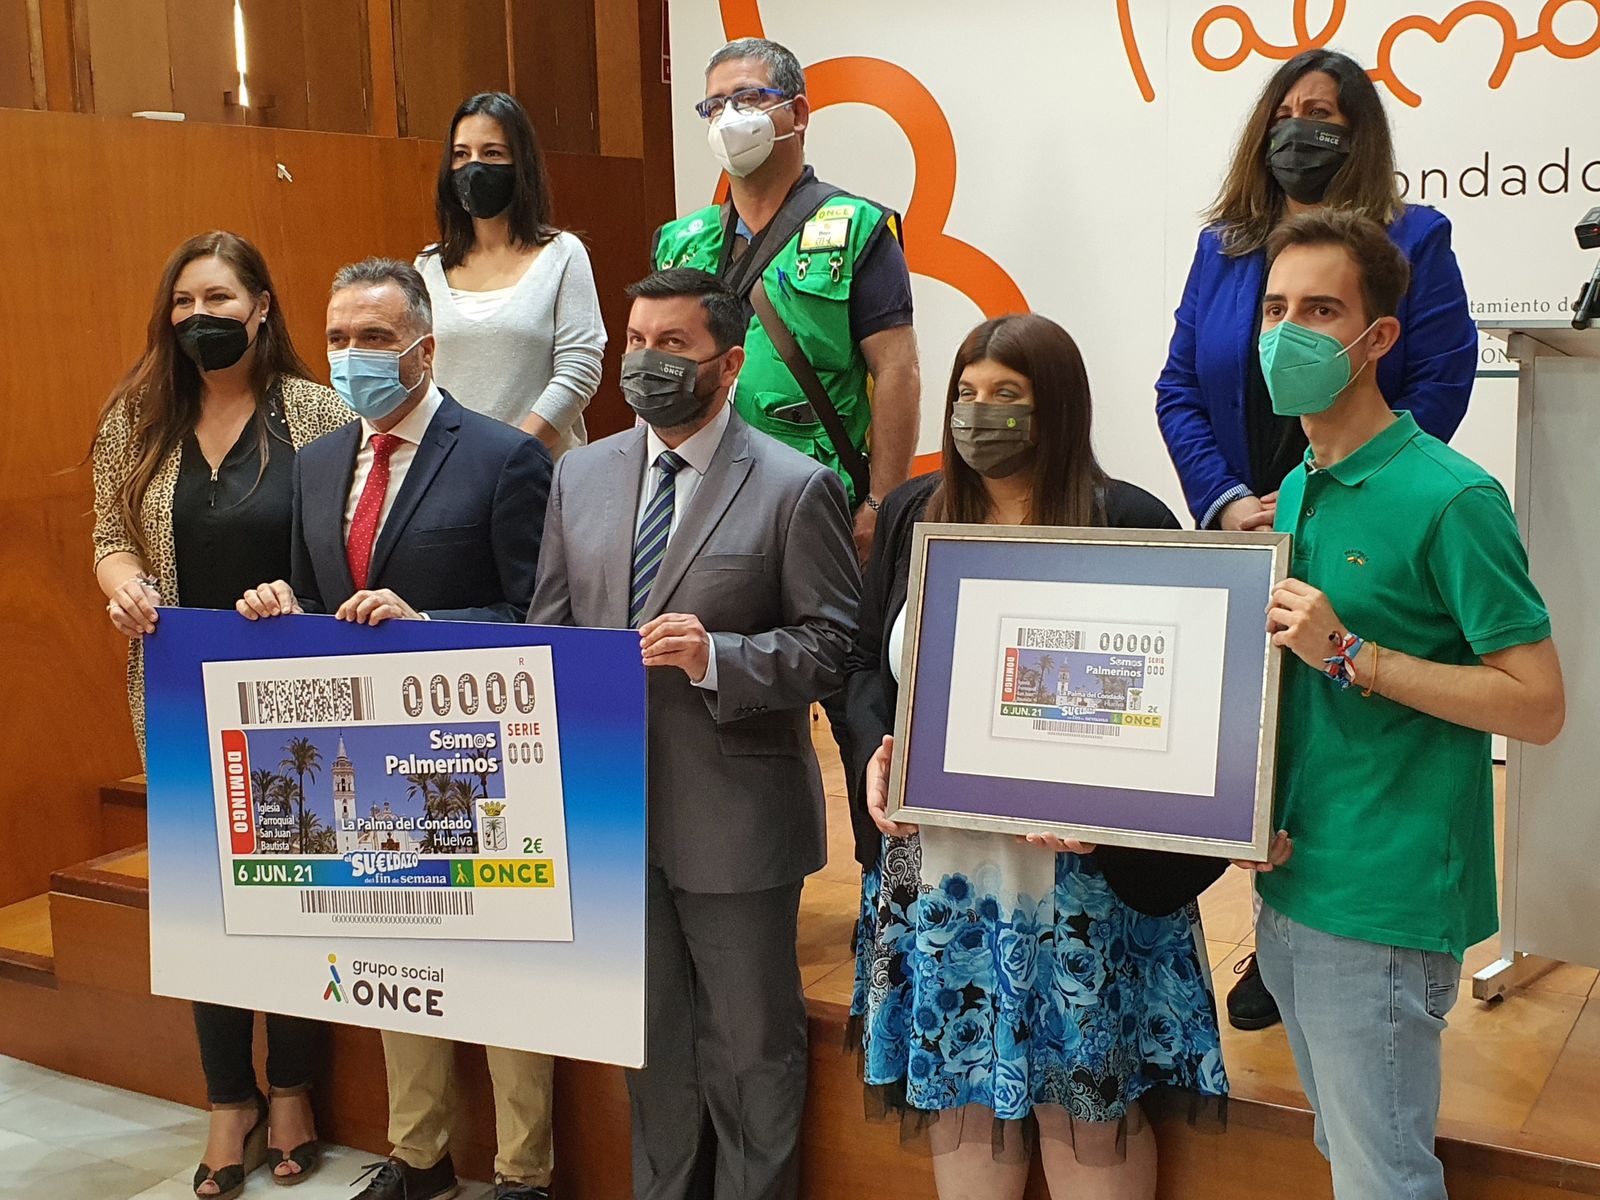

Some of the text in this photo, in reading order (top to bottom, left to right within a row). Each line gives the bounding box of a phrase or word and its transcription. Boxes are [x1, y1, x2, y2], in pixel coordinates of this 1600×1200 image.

[1392, 147, 1600, 201] ondado
[818, 208, 849, 219] ONCE
[1470, 297, 1550, 313] tamiento
[663, 366, 684, 377] ONCE
[1099, 632, 1165, 655] 00000
[518, 657, 525, 666] R
[1004, 656, 1015, 693] DOMINGO
[1085, 665, 1142, 678] Palmerinos
[1146, 665, 1165, 676] 000
[1097, 692, 1125, 701] Condado
[1002, 706, 1009, 715] 6
[1124, 715, 1160, 726] ONCE
[507, 722, 541, 736] SERIE
[508, 742, 544, 764] 000
[385, 753, 499, 776] Palmerinos
[227, 751, 249, 833] DOMINGO
[257, 803, 281, 818] Iglesia
[259, 815, 295, 828] Parroquial
[341, 816, 472, 831] La Palma del Condado
[260, 828, 291, 838] San Juan
[433, 833, 473, 847] Huelva
[261, 841, 290, 851] Bautista
[522, 837, 544, 854] 2€
[238, 864, 249, 882] 6
[375, 873, 391, 883] fin
[400, 874, 447, 884] semana
[479, 863, 549, 884] ONCE
[352, 960, 444, 983] grupo social
[352, 980, 444, 1017] ONCE
